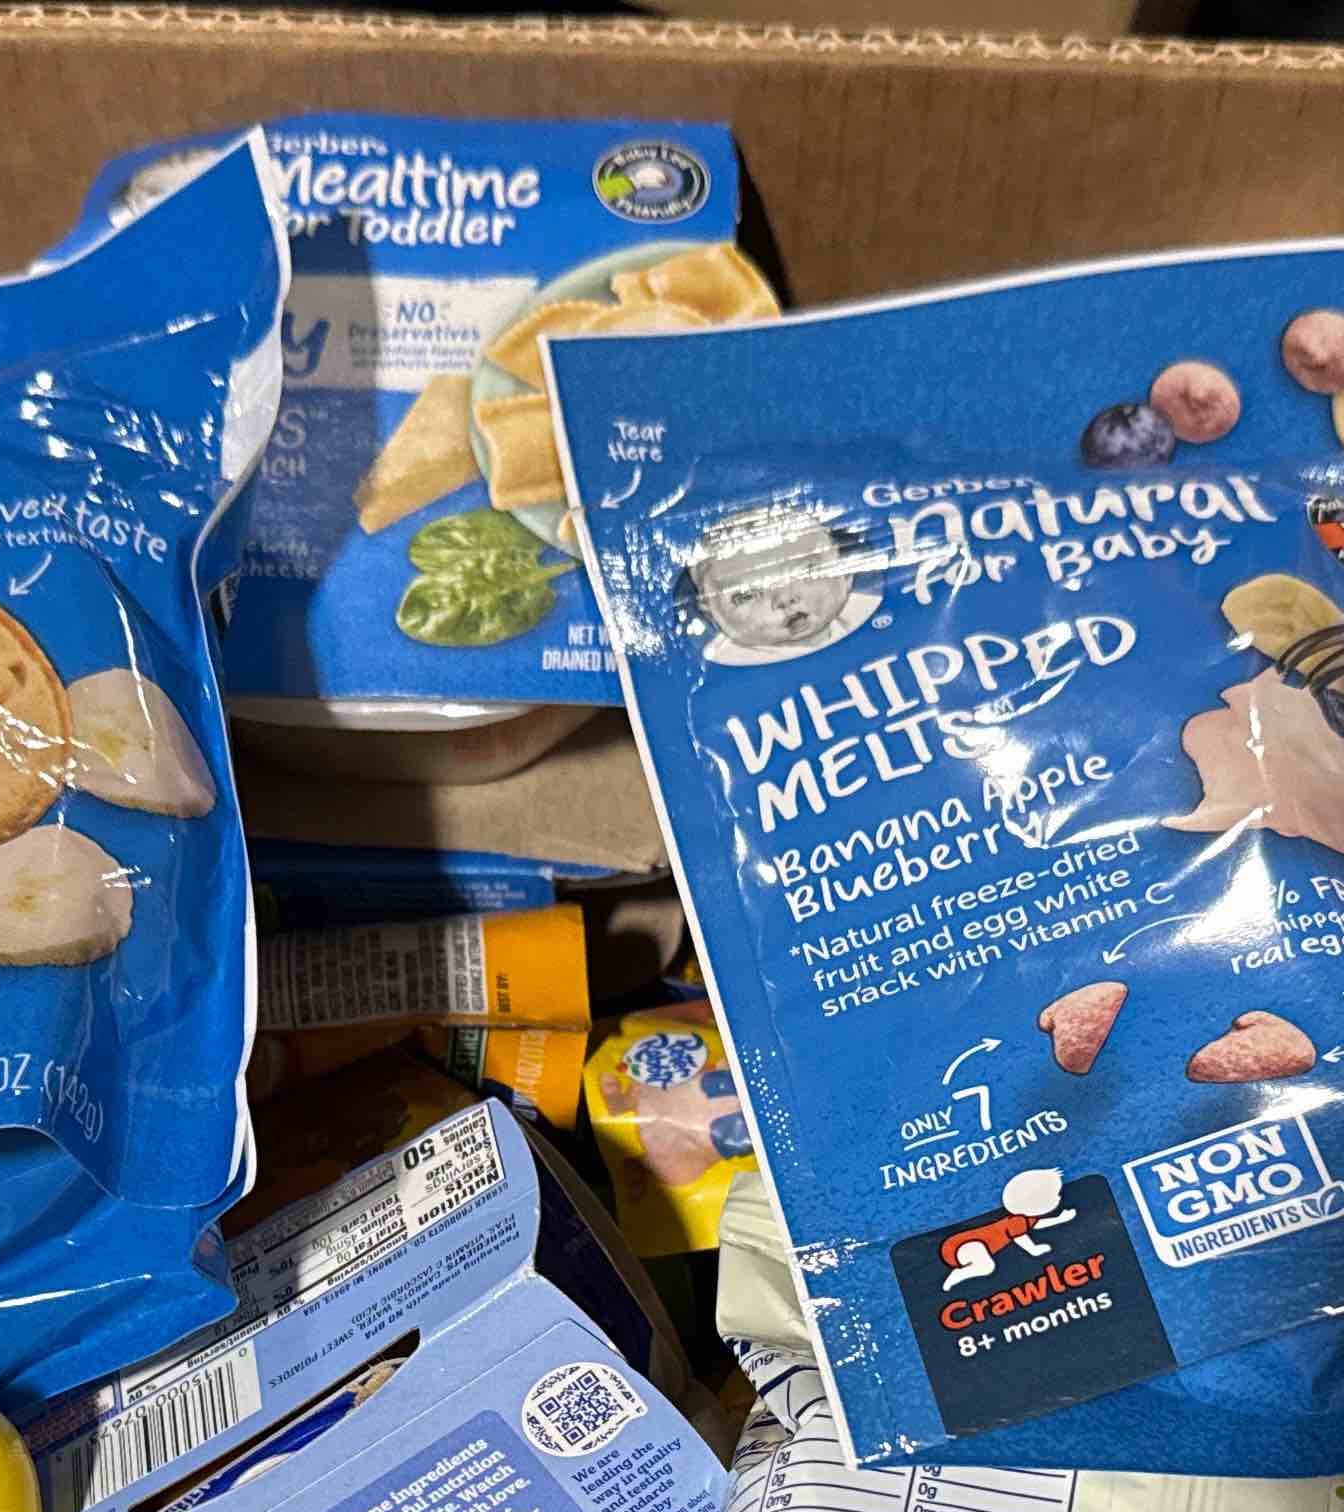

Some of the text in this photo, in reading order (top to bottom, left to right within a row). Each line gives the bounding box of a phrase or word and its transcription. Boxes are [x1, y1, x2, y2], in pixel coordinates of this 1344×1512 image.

[274, 151, 539, 208] Mealtime
[346, 208, 515, 247] Toddler
[397, 302, 436, 323] NO
[608, 421, 666, 462] Tear Here
[76, 506, 171, 561] taste
[903, 522, 1232, 602] for Baby
[727, 616, 1135, 771] WHIPPED
[774, 755, 1113, 884] Banana Apple
[930, 834, 1141, 919] freeze-dried
[812, 869, 1131, 992] fruit and egg white
[821, 904, 1141, 1016] snack with vitamin
[1230, 940, 1293, 974] real
[40, 1059, 102, 1142] (142g)
[900, 1110, 953, 1142] ONLY
[404, 1139, 435, 1170] 50
[880, 1109, 1067, 1190] INGREDIENTS
[1152, 1125, 1283, 1192] NON
[417, 1170, 500, 1226] Nutrition
[1166, 1161, 1304, 1224] GMO
[1171, 1206, 1302, 1259] INGREDIENTS
[937, 1256, 1106, 1331] Crawler
[957, 1291, 1113, 1358] 8+ months
[390, 1440, 488, 1502] ingredients
[429, 1451, 505, 1498] nutrition
[456, 1465, 514, 1503] Watch
